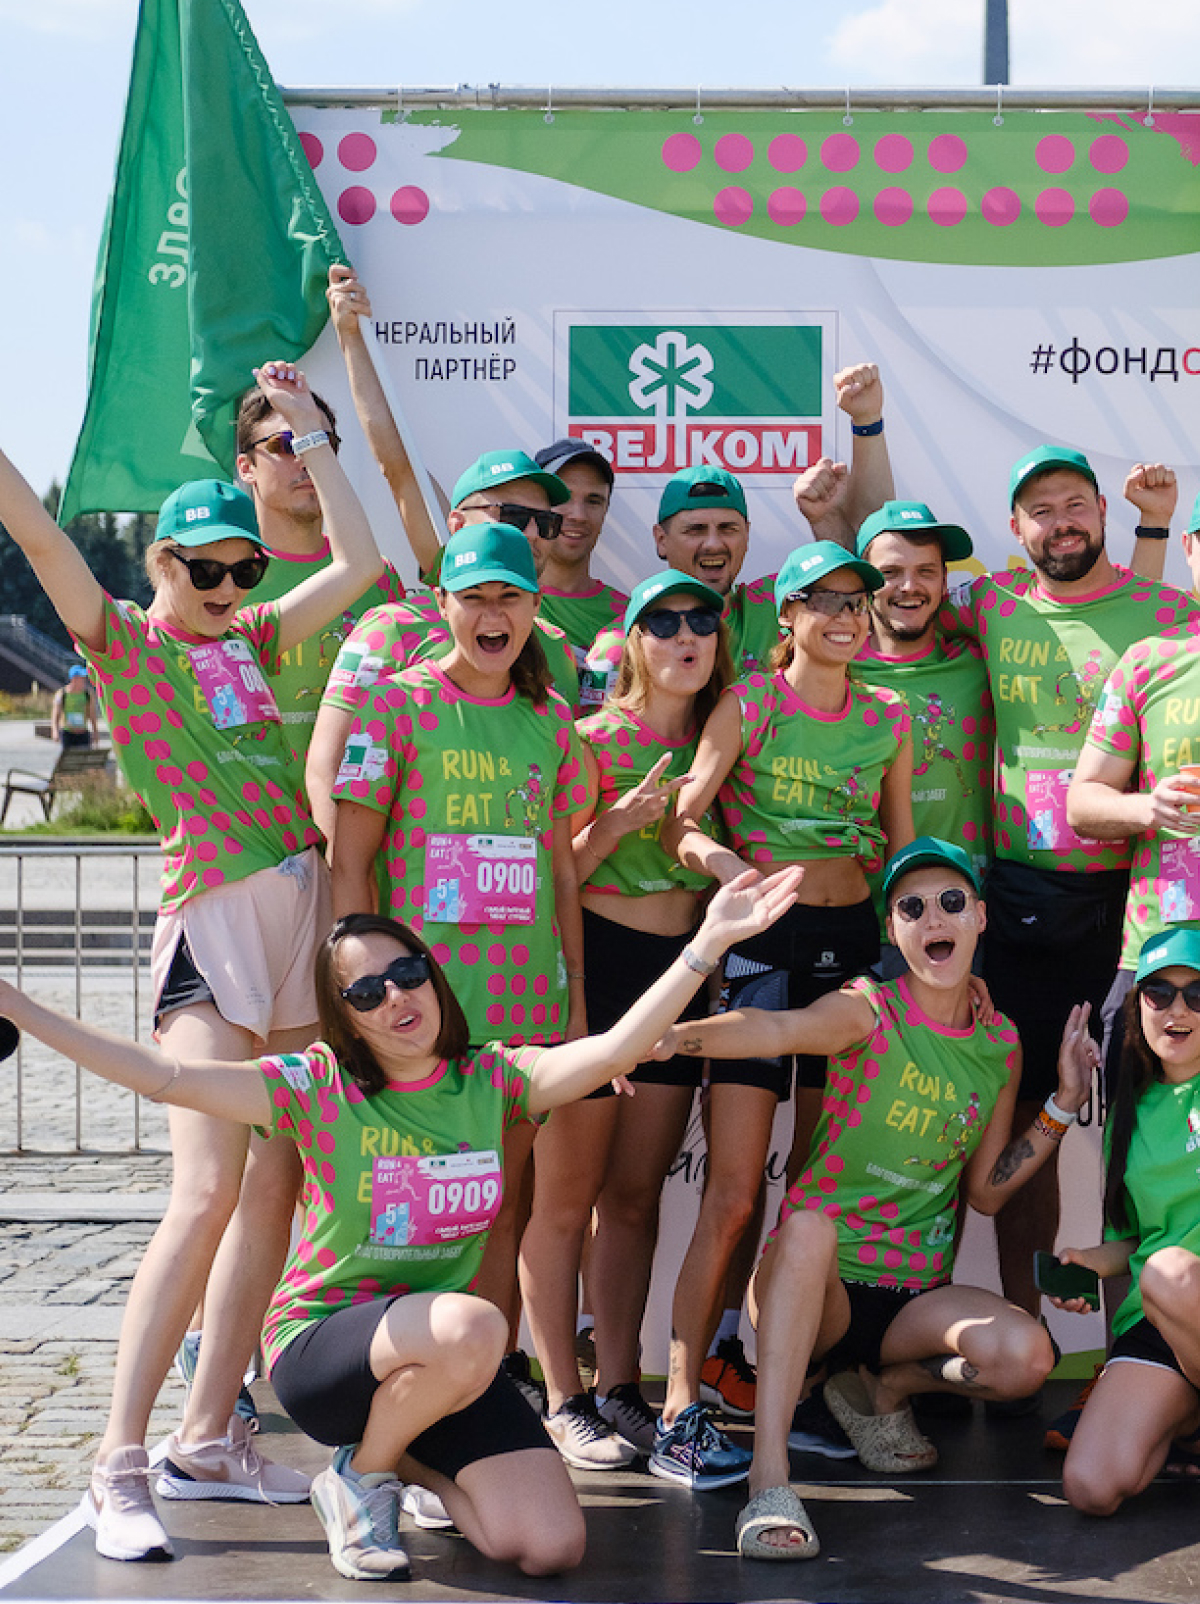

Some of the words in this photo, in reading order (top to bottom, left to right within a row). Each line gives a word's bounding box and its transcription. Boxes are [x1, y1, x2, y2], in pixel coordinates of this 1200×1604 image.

[374, 316, 517, 345] НЕРАЛЬНЫЙ
[415, 352, 517, 381] ПАРТНЁР
[998, 637, 1051, 667] RUN
[1054, 644, 1069, 663] &
[998, 675, 1043, 703] EAT
[442, 749, 495, 782] RUN
[500, 757, 512, 776] &
[772, 755, 822, 782] RUN
[446, 793, 493, 826] EAT
[477, 861, 534, 895] 0900
[899, 1061, 940, 1102] RUN
[944, 1082, 957, 1102] &
[884, 1099, 938, 1138] EAT
[360, 1125, 420, 1157] RUN
[422, 1137, 438, 1155] &
[428, 1178, 499, 1215] 0909
